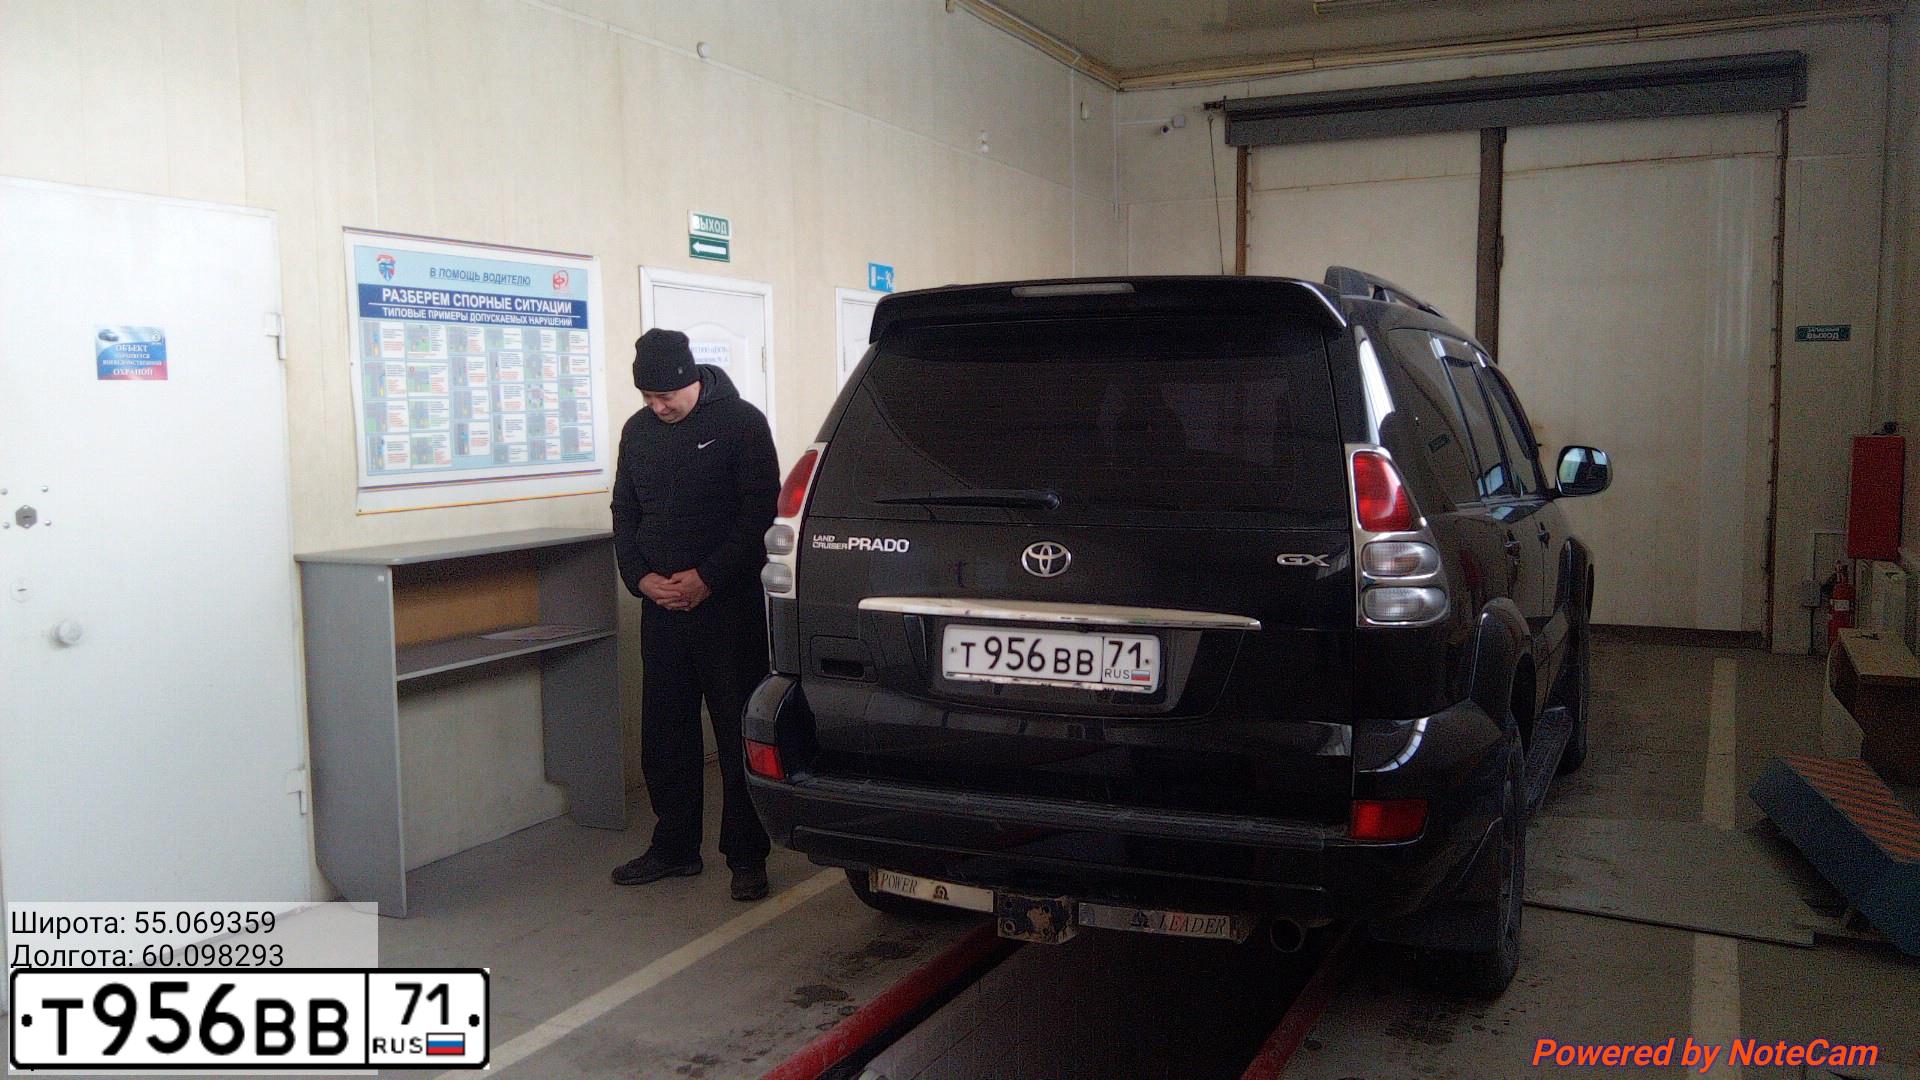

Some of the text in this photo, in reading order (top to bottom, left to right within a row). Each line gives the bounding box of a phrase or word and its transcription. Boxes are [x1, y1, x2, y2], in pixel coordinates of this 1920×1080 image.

[692, 215, 728, 236] ВЫХОД
[430, 267, 531, 287] В ПОМОЩЬ ВОДИТЕЛЮ
[382, 287, 572, 315] РАЗБЕРЕМ СПОРНЫЕ СИТУАЦИИ
[382, 307, 427, 319] ТИПОВЫЕ
[428, 309, 468, 321] ПРИМЕРЫ
[470, 312, 528, 325] ДОПУСКАЕМЫХ
[812, 537, 910, 553] CRUISER PRADO
[813, 534, 836, 543] LAND
[1276, 553, 1330, 567] GX
[1108, 640, 1142, 669] 71
[1104, 668, 1130, 680] RUS
[881, 872, 918, 895] POWER
[1159, 913, 1227, 935] LEADER
